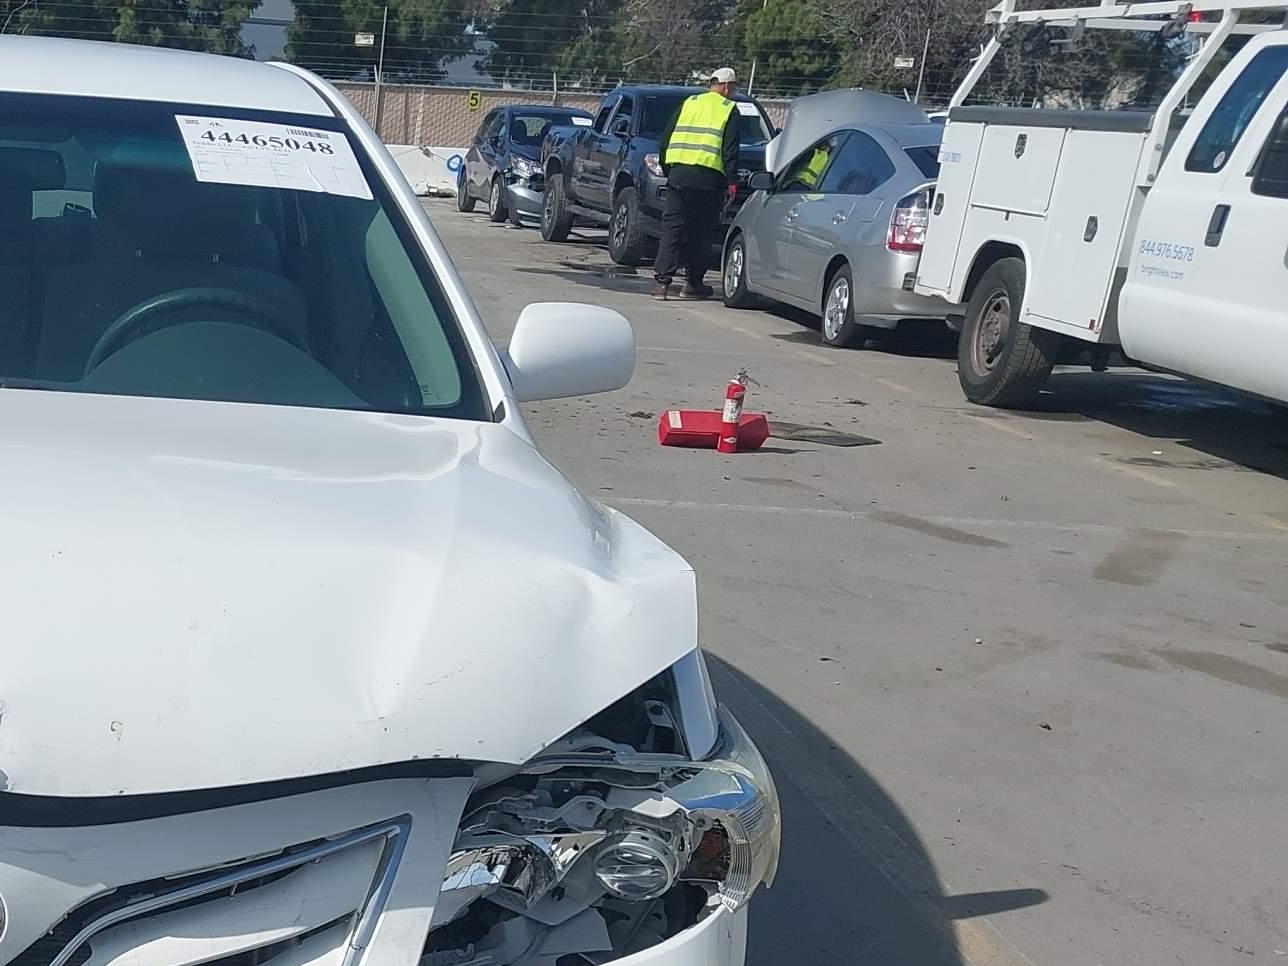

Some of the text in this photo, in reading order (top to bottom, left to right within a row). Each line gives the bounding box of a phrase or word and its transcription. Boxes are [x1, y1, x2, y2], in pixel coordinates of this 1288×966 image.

[469, 92, 480, 107] 5
[200, 129, 335, 155] 44465048
[1140, 239, 1194, 262] 844.976.5678
